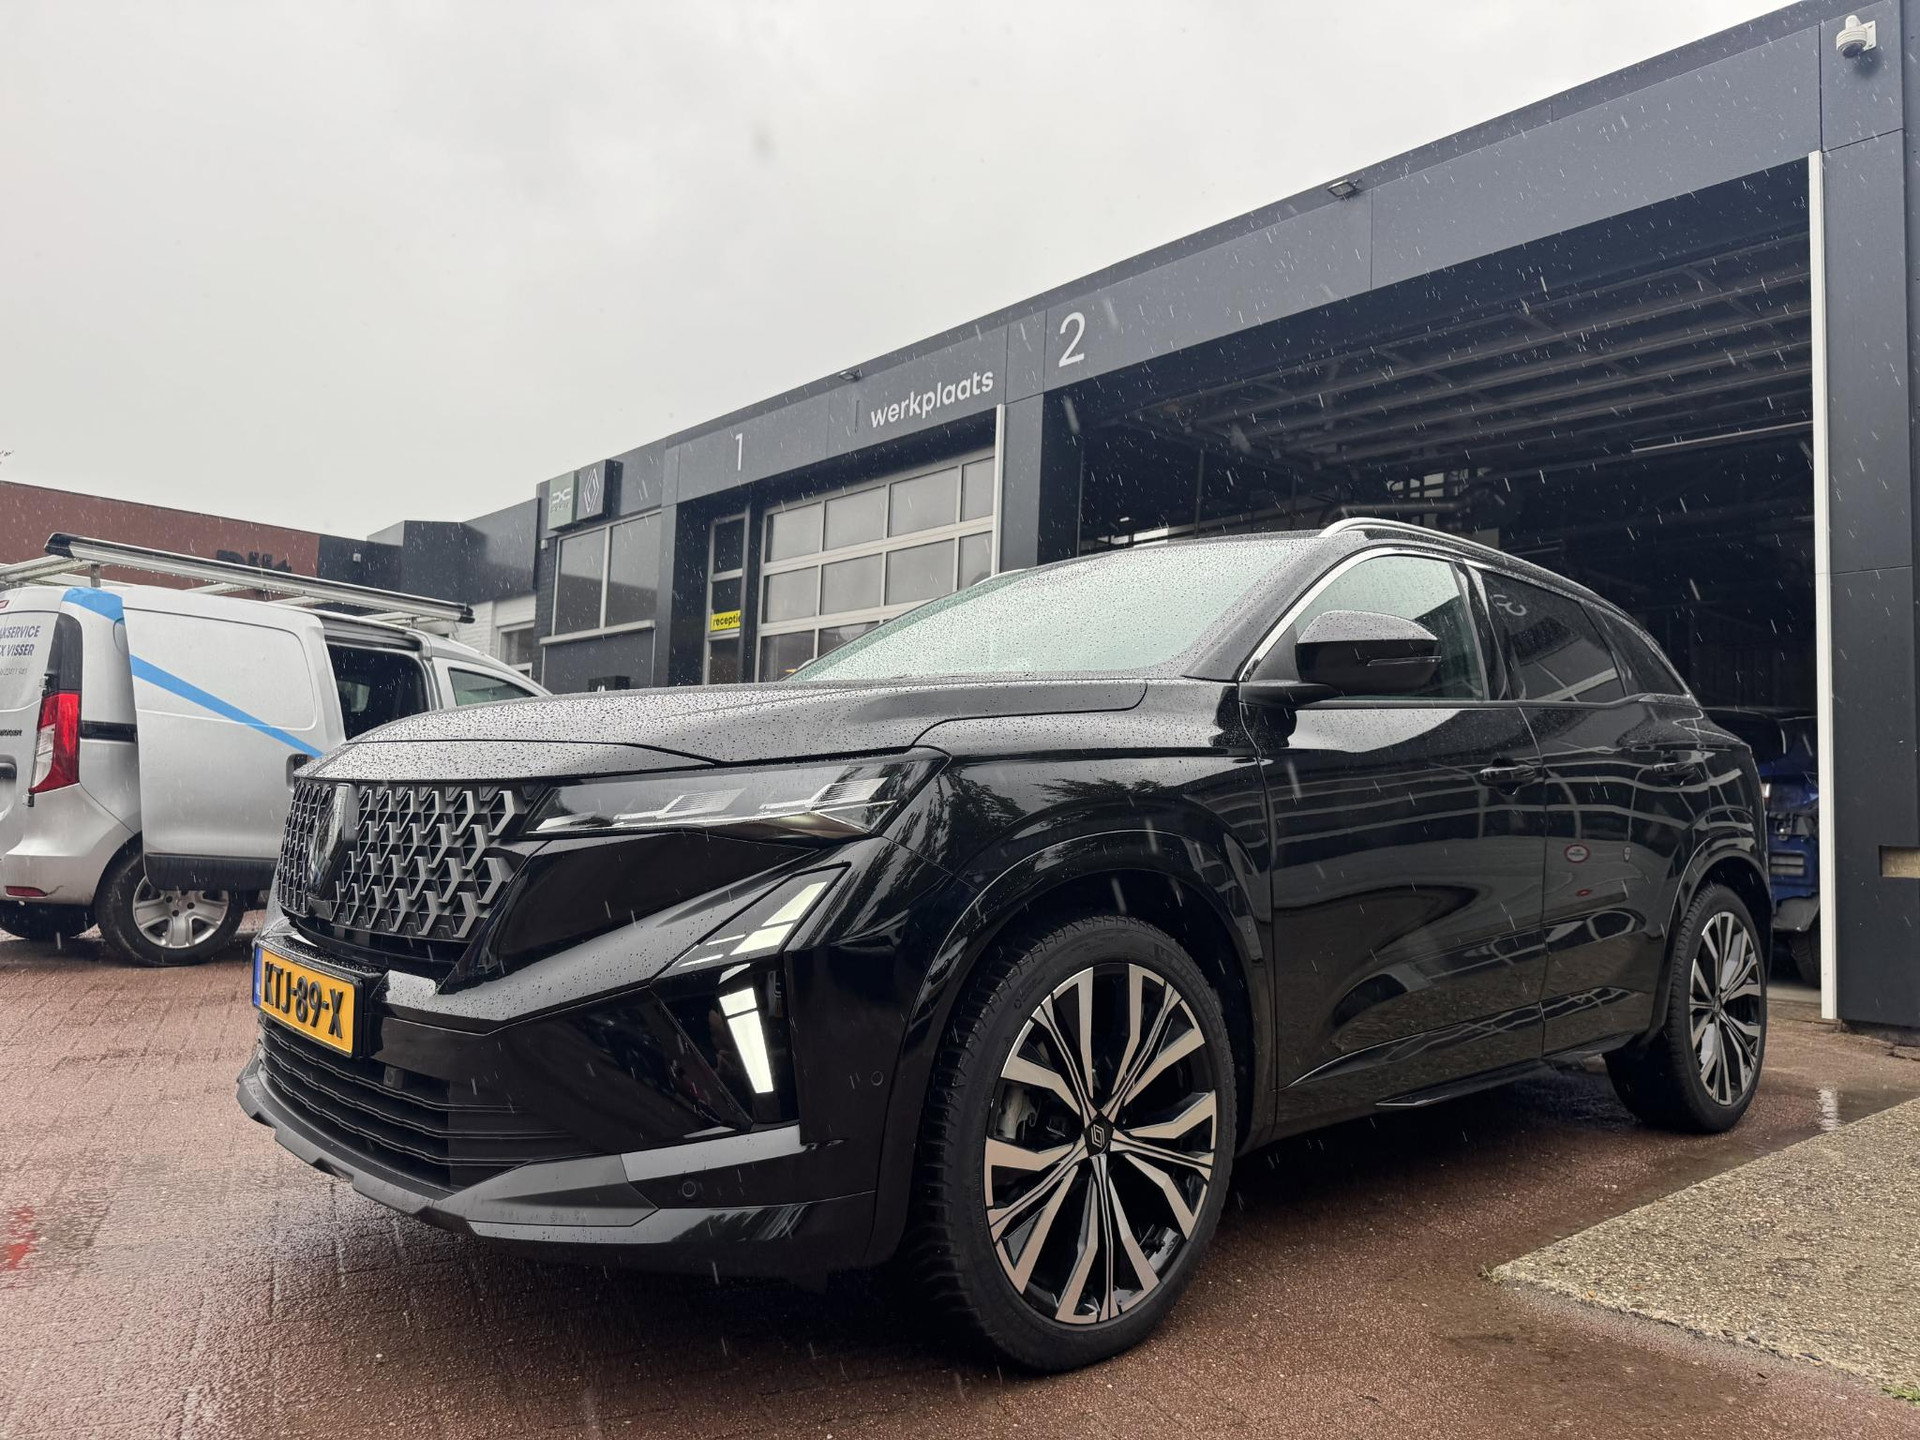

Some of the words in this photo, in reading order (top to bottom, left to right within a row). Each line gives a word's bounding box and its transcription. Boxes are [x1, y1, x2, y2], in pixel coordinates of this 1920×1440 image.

[1058, 311, 1086, 368] 2
[870, 370, 994, 429] werkplaats
[735, 433, 743, 471] 1
[7, 643, 35, 656] VISSER
[264, 961, 344, 1039] KTJ-89-X
